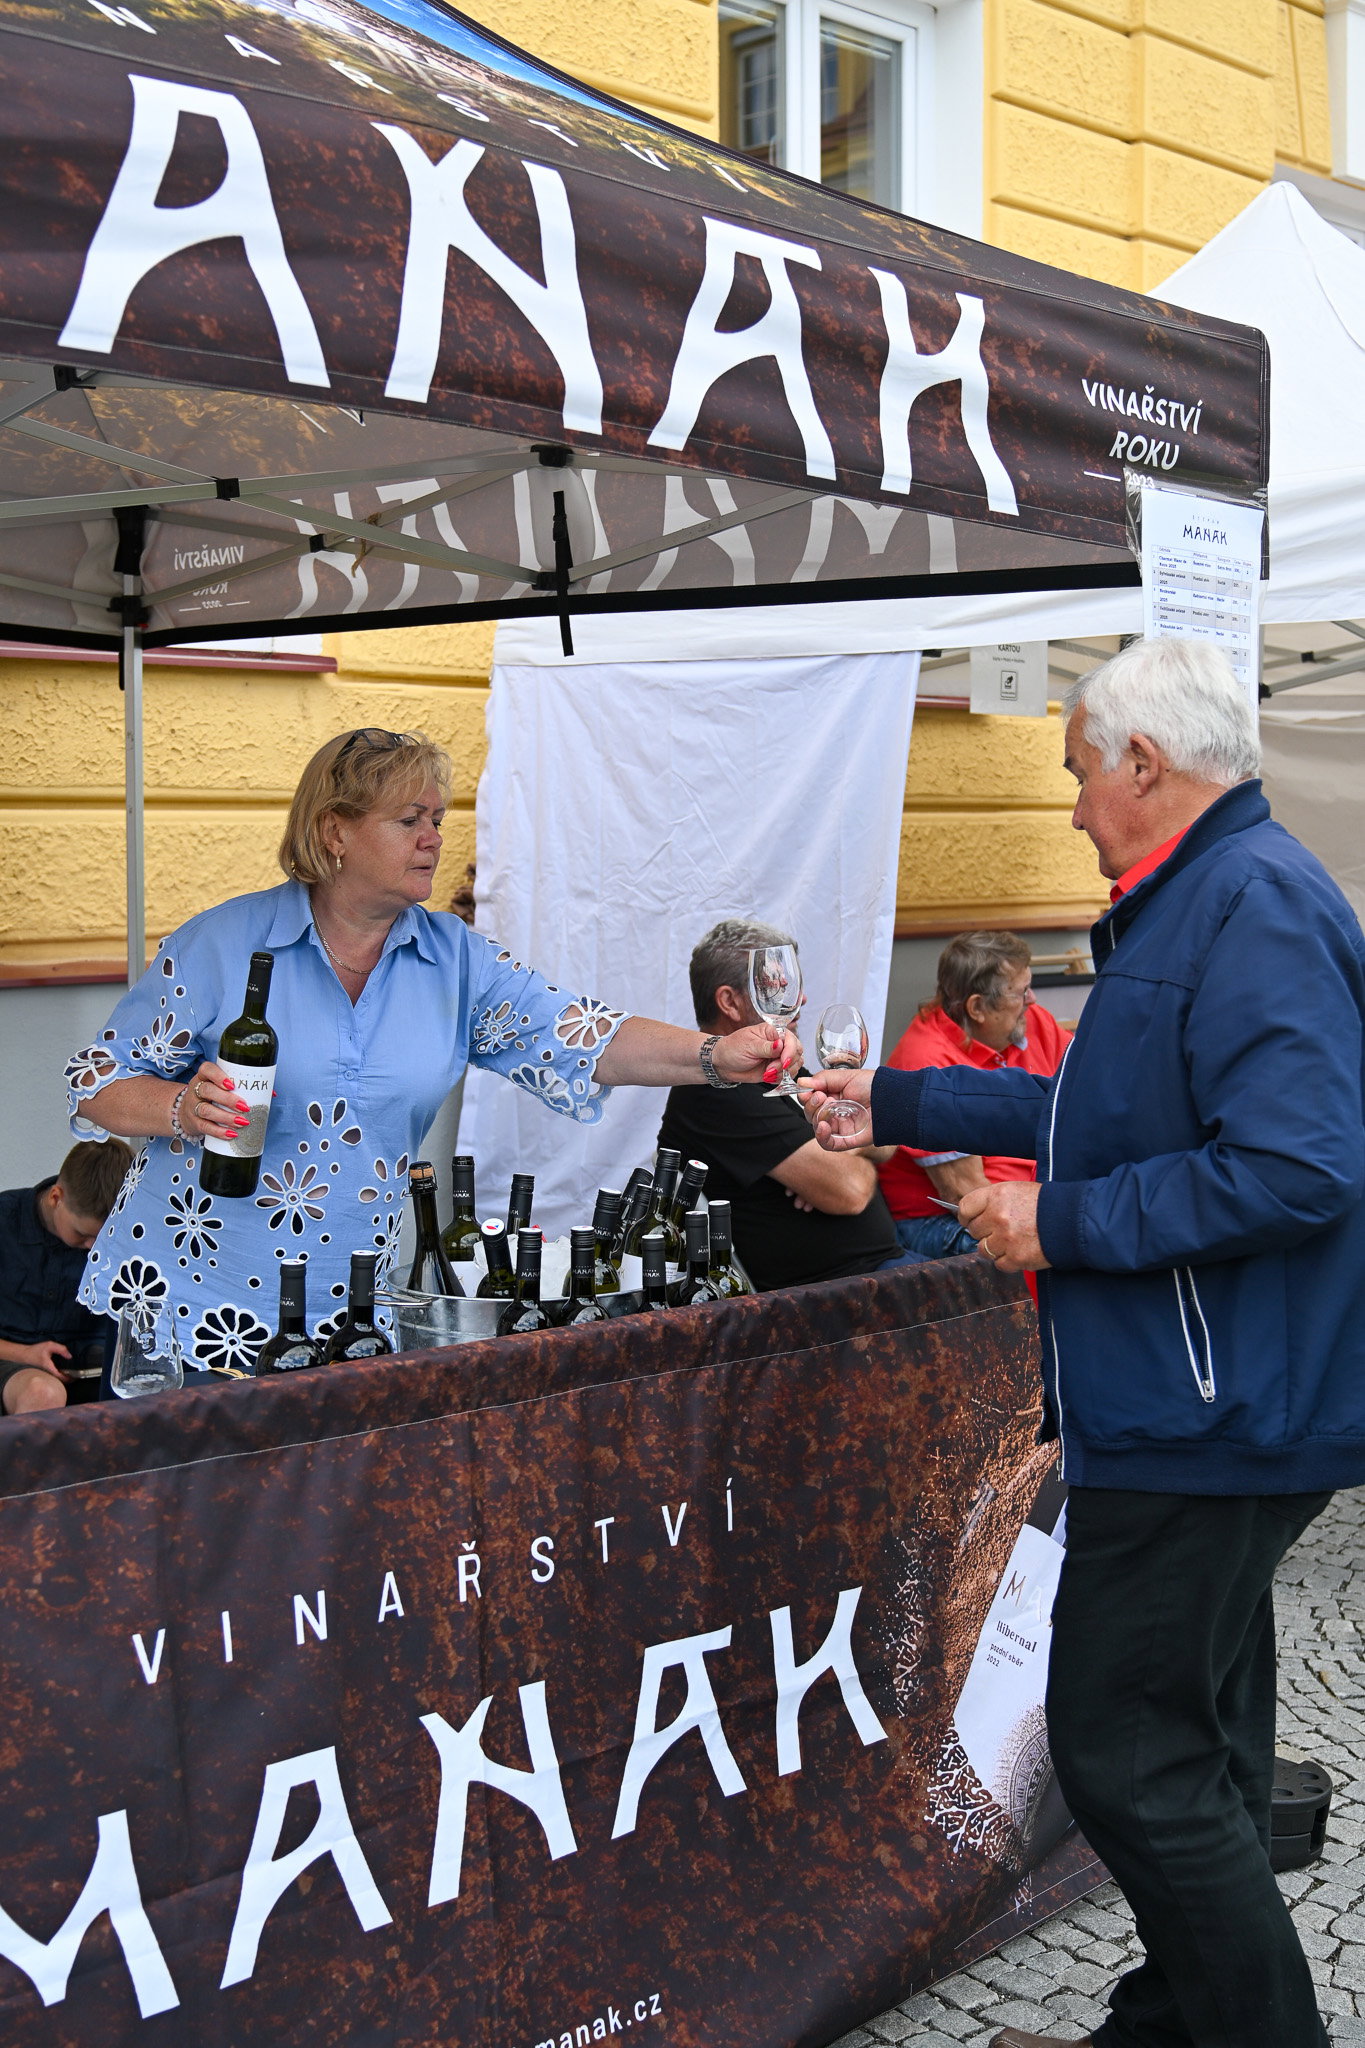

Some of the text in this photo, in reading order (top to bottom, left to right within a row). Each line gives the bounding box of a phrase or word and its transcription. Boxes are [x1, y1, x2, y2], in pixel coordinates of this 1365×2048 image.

[1081, 378, 1203, 435] VINAŘSTVÍ
[1109, 430, 1180, 471] ROKU
[1125, 471, 1156, 489] 2023
[998, 644, 1021, 653] KARTOU
[132, 1477, 735, 1685] VINAŘSTVÍ
[996, 1620, 1038, 1653] Hibernal
[986, 1653, 1001, 1668] 2022
